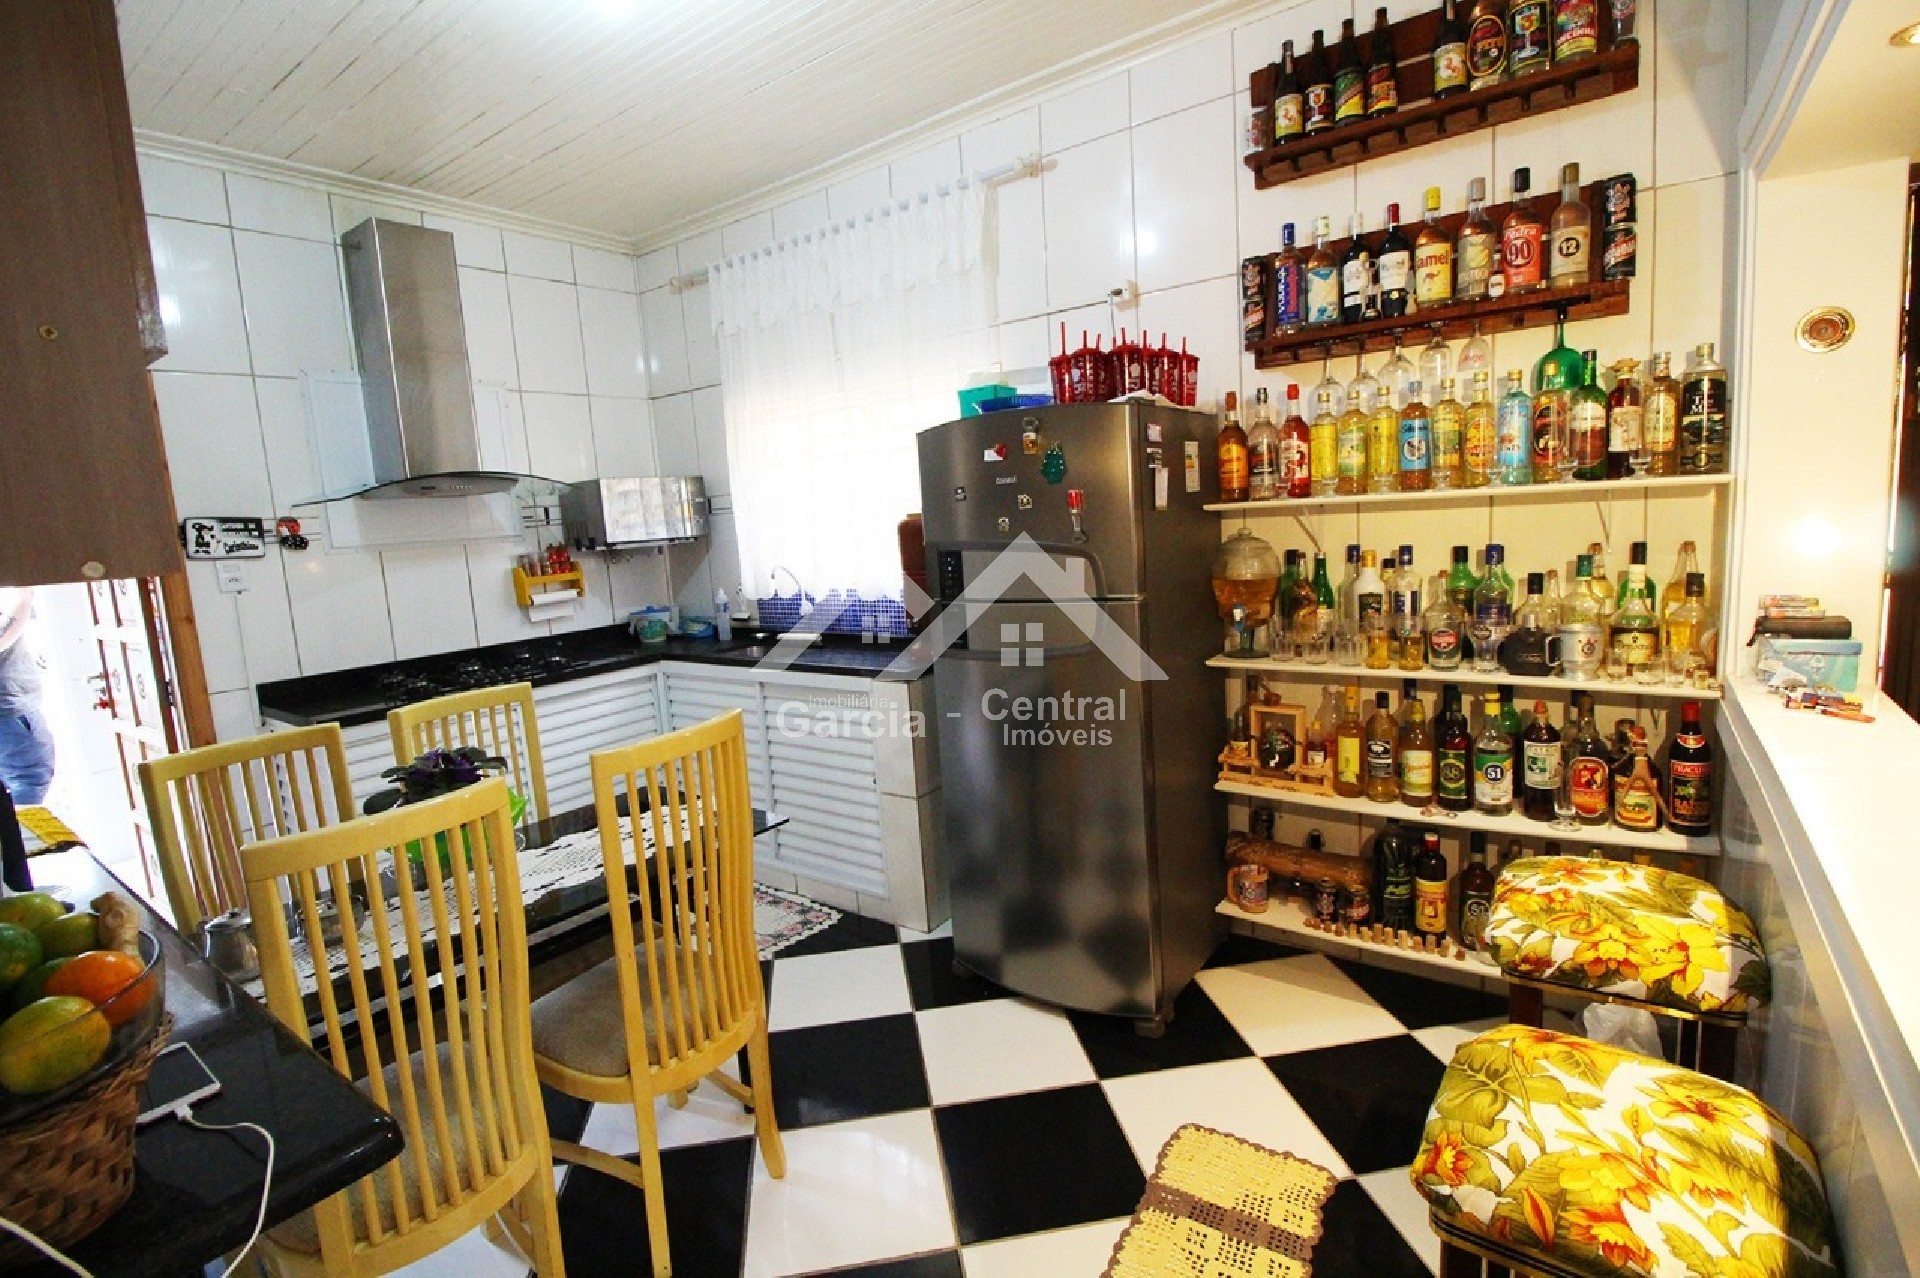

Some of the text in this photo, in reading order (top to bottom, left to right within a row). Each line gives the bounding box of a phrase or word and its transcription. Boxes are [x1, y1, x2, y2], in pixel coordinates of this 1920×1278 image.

[1415, 249, 1449, 269] amel
[1508, 246, 1529, 262] 90
[1487, 767, 1501, 779] 51
